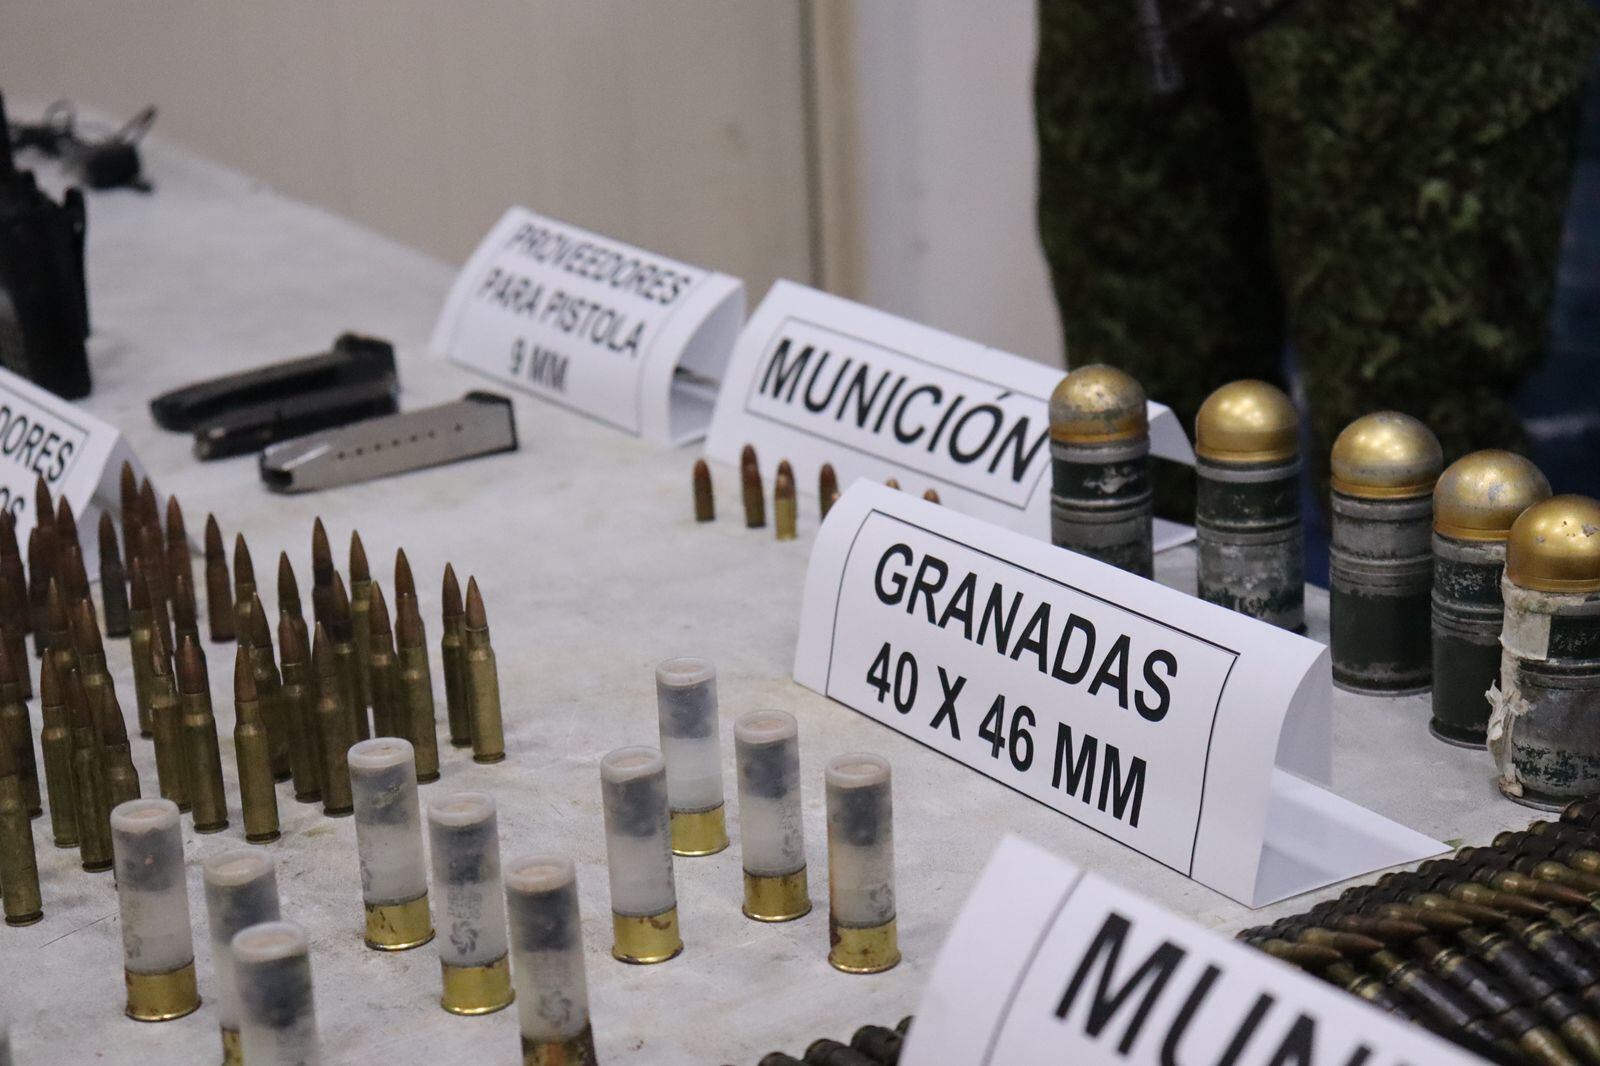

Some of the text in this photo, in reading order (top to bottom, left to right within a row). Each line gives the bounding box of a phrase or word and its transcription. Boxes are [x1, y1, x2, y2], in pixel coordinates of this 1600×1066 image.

[478, 268, 646, 358] PARA PISTOLA
[509, 223, 691, 304] PROVEEDORES
[510, 336, 570, 392] 9 MM
[759, 338, 1051, 483] MUNICIÓN
[873, 542, 1179, 723] GRANADAS
[865, 641, 1148, 829] 40 X 46 MM
